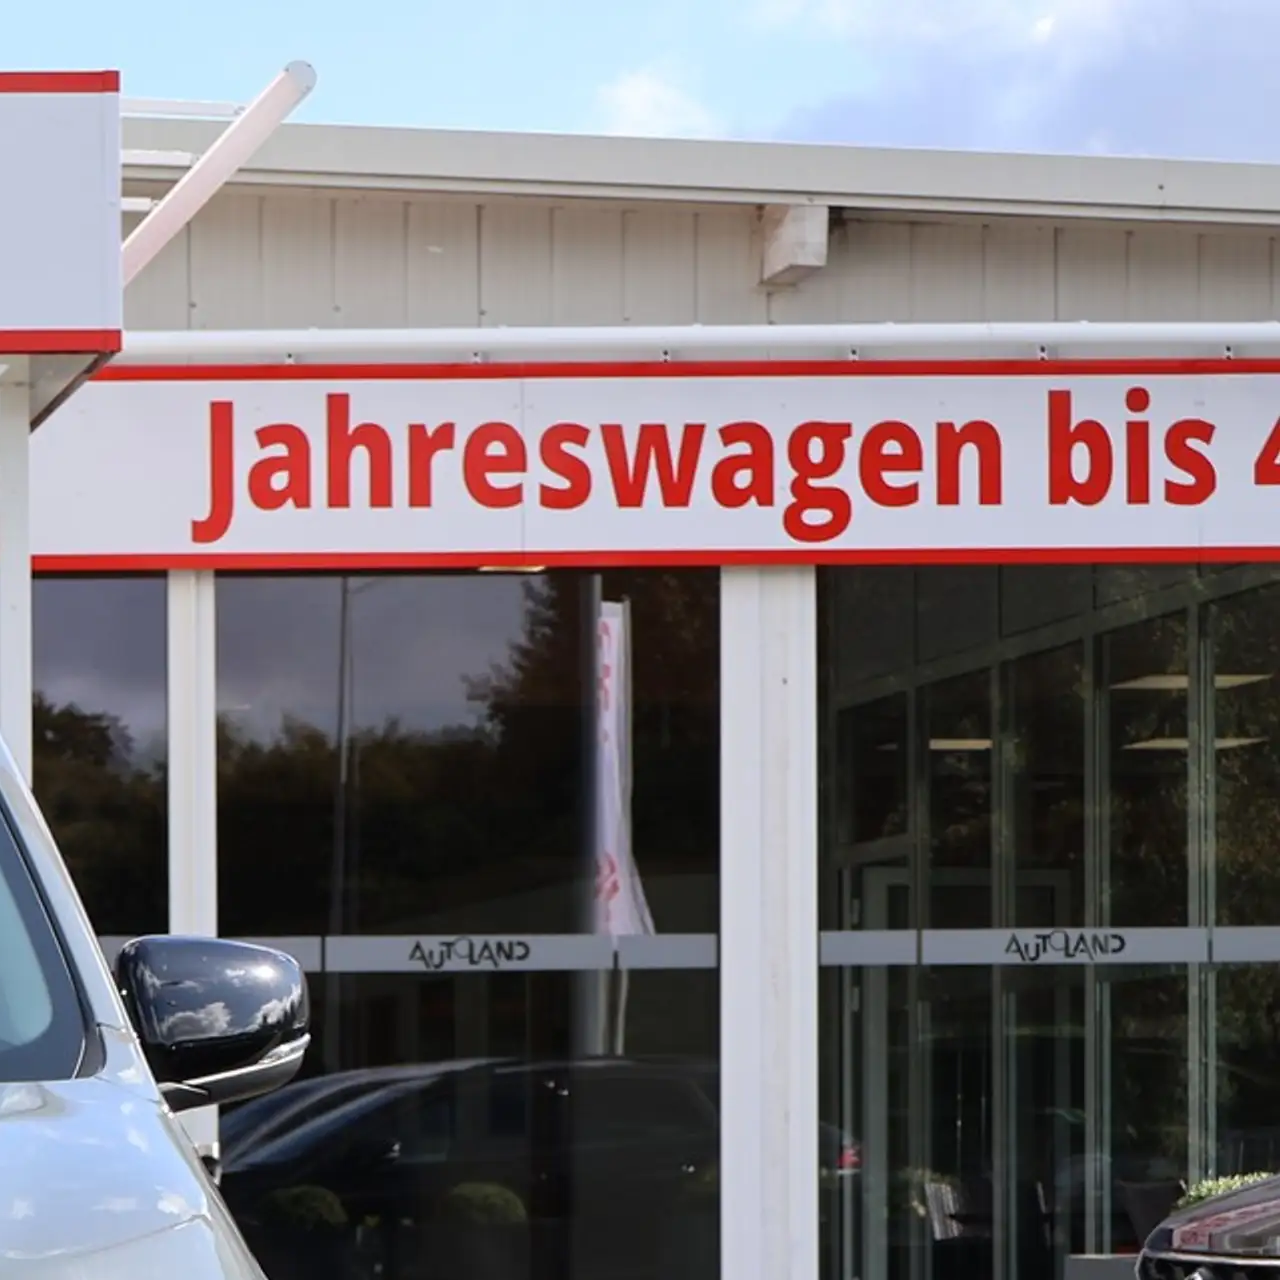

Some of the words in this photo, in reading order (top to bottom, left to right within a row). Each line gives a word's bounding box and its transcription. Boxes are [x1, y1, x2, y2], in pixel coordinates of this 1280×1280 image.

[192, 393, 1002, 543] Jahreswagen
[1048, 387, 1217, 506] bis
[409, 936, 530, 969] AUTOLAND
[1005, 929, 1126, 961] AUTOLAND
